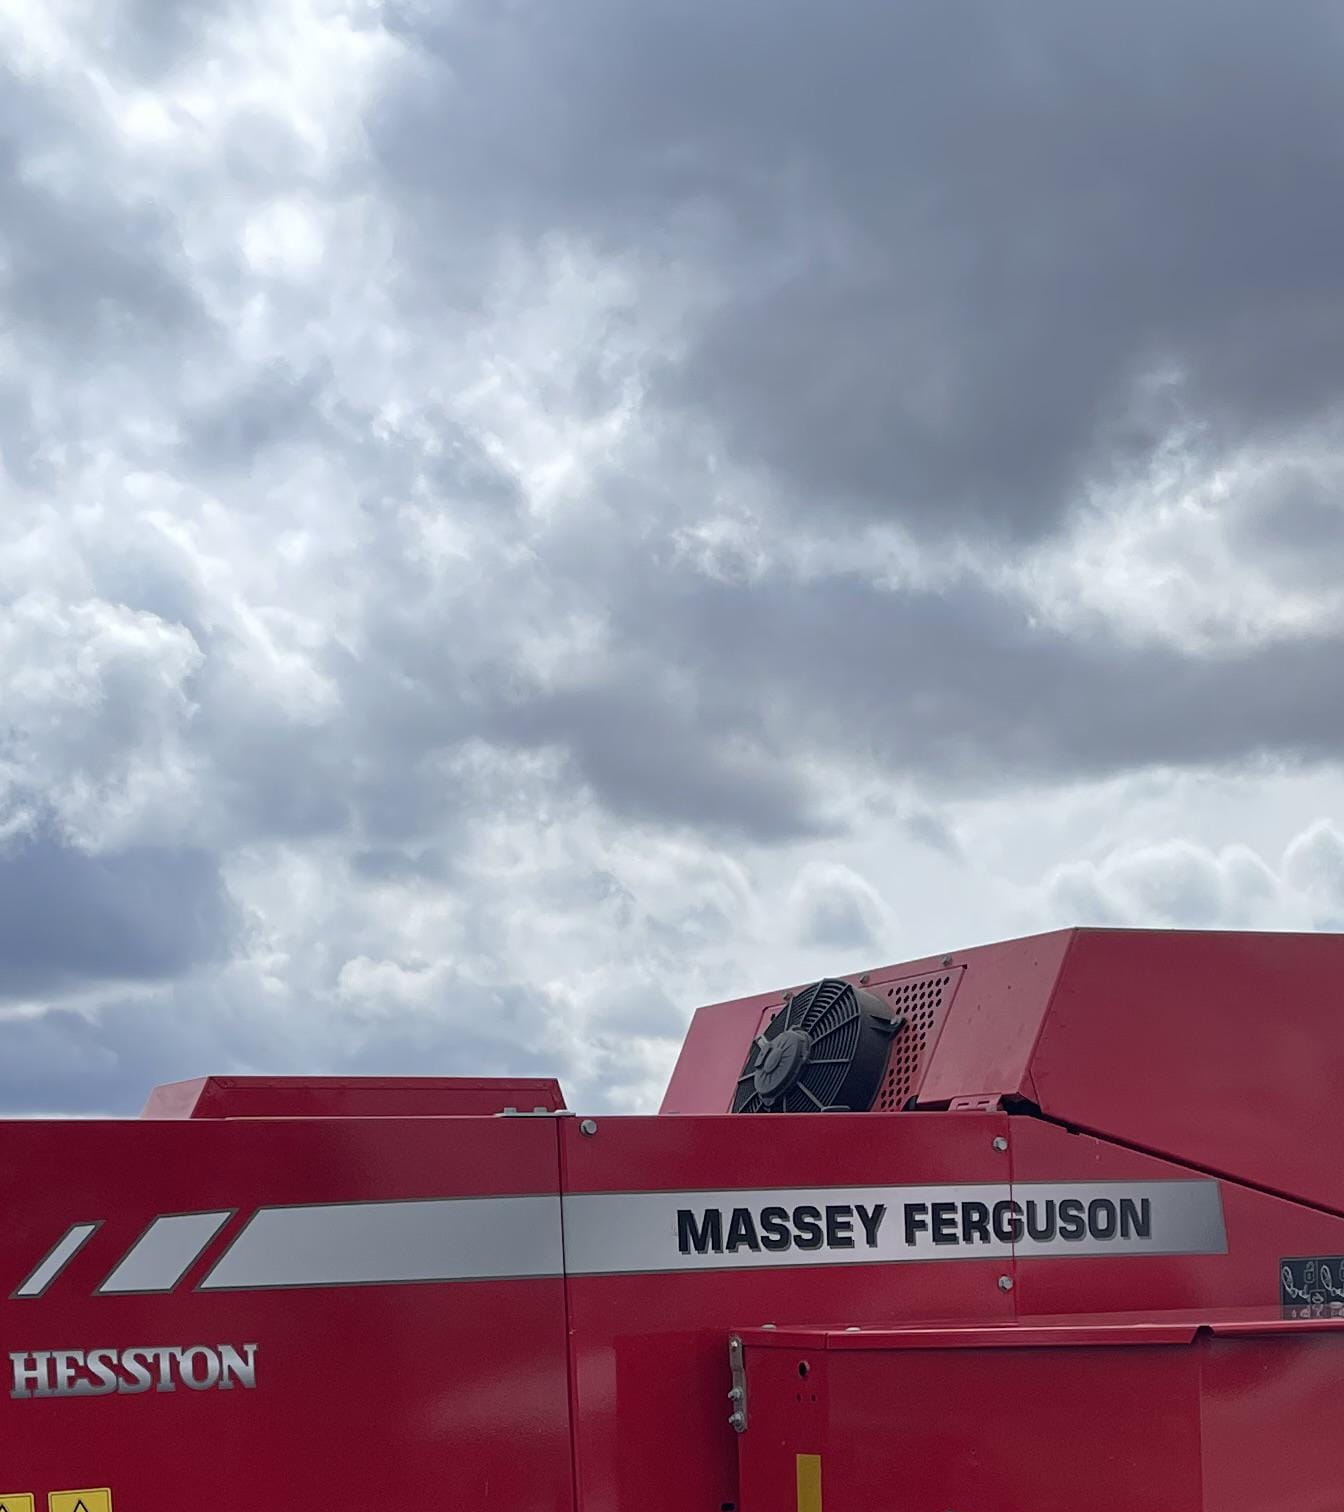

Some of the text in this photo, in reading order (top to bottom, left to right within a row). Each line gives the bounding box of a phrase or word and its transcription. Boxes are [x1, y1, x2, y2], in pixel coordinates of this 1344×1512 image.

[676, 1197, 1152, 1255] MASSEY FERGUSON
[8, 1343, 258, 1399] HESSTON
